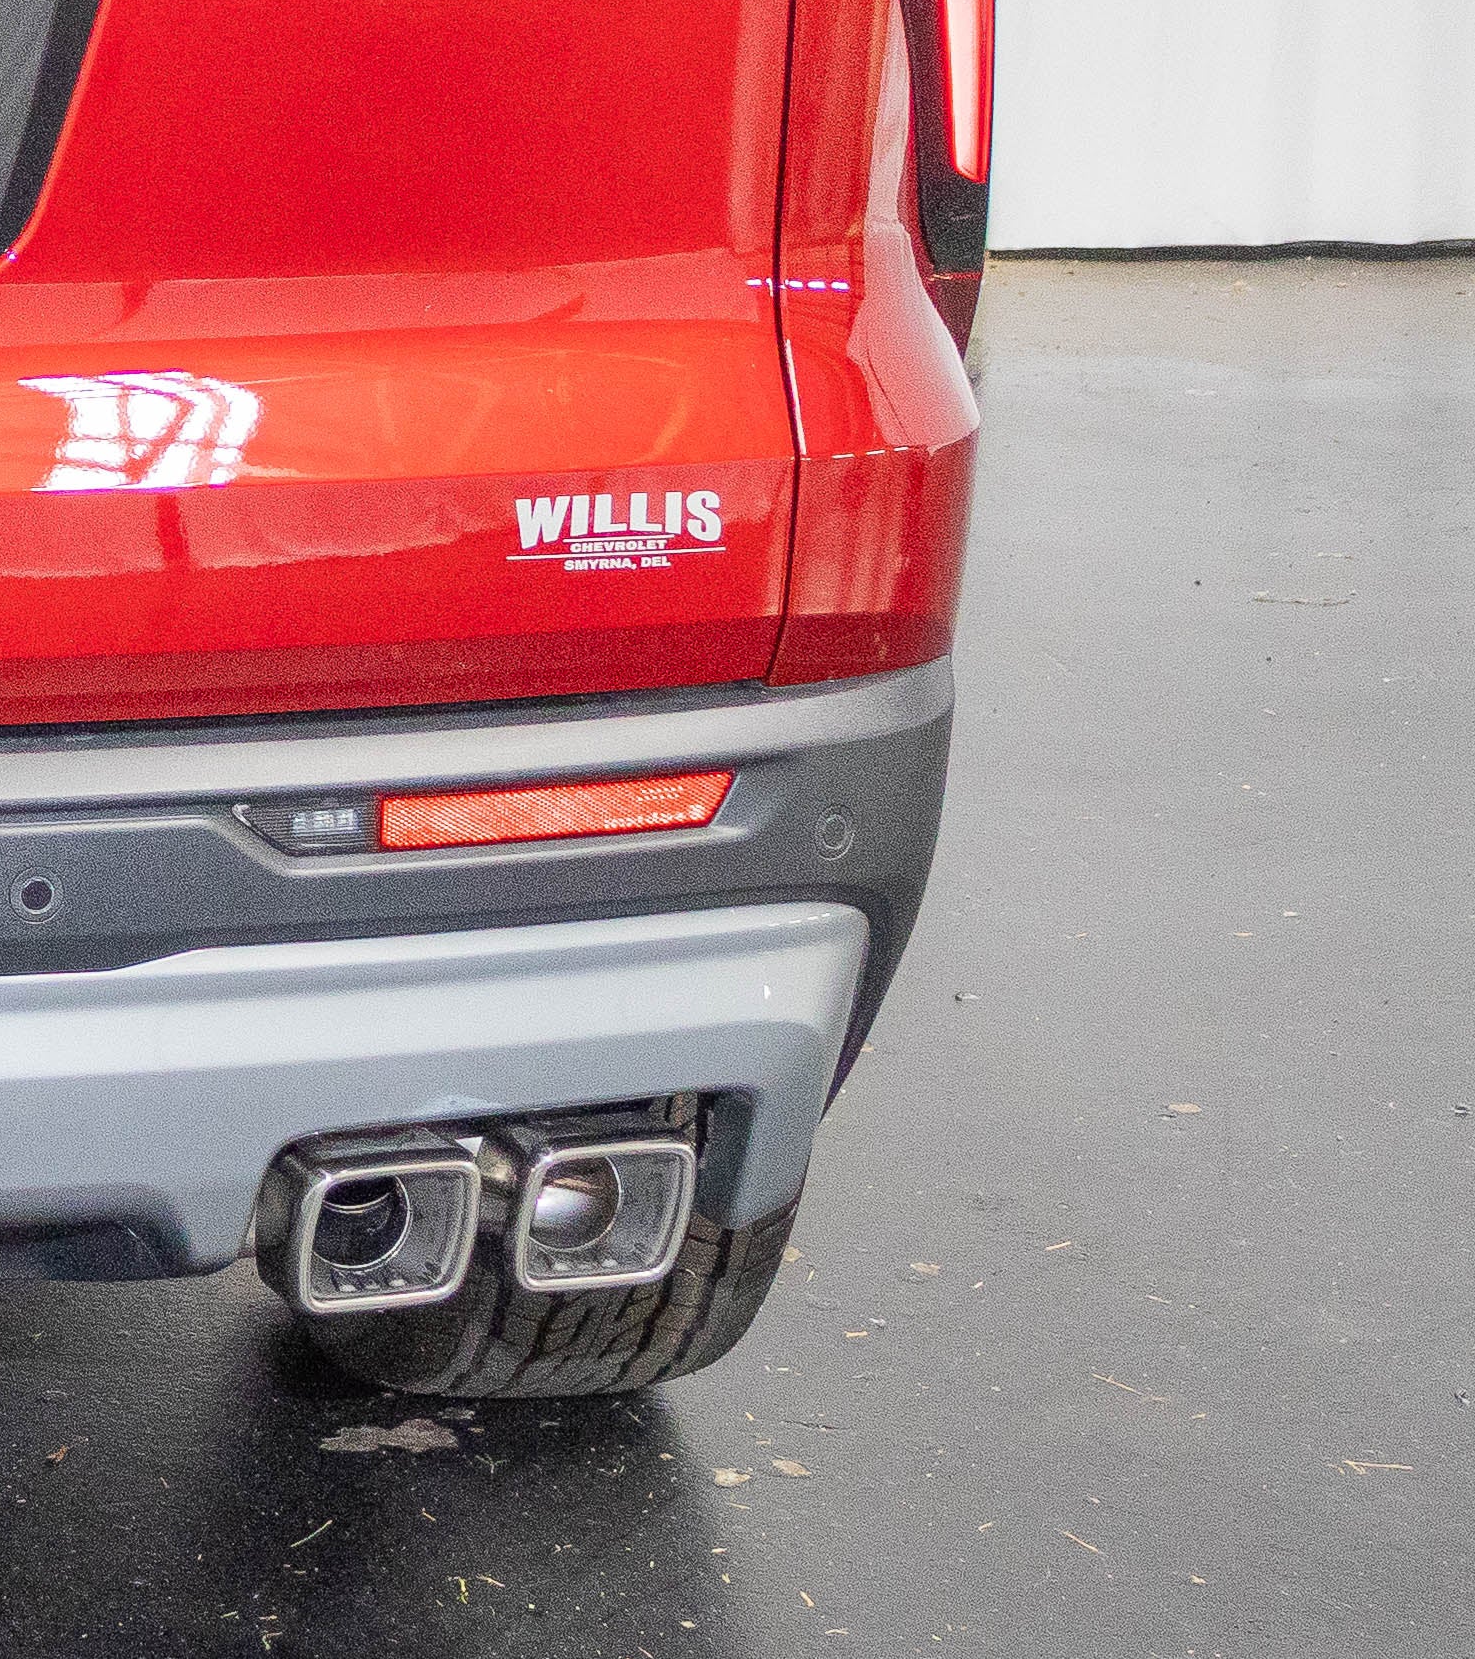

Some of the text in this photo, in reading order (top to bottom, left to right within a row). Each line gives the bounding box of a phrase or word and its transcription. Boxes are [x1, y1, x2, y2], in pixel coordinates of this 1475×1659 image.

[515, 490, 722, 550] WILLIS
[570, 539, 668, 553] CHEVROLET
[563, 557, 637, 571] SMYRNA,
